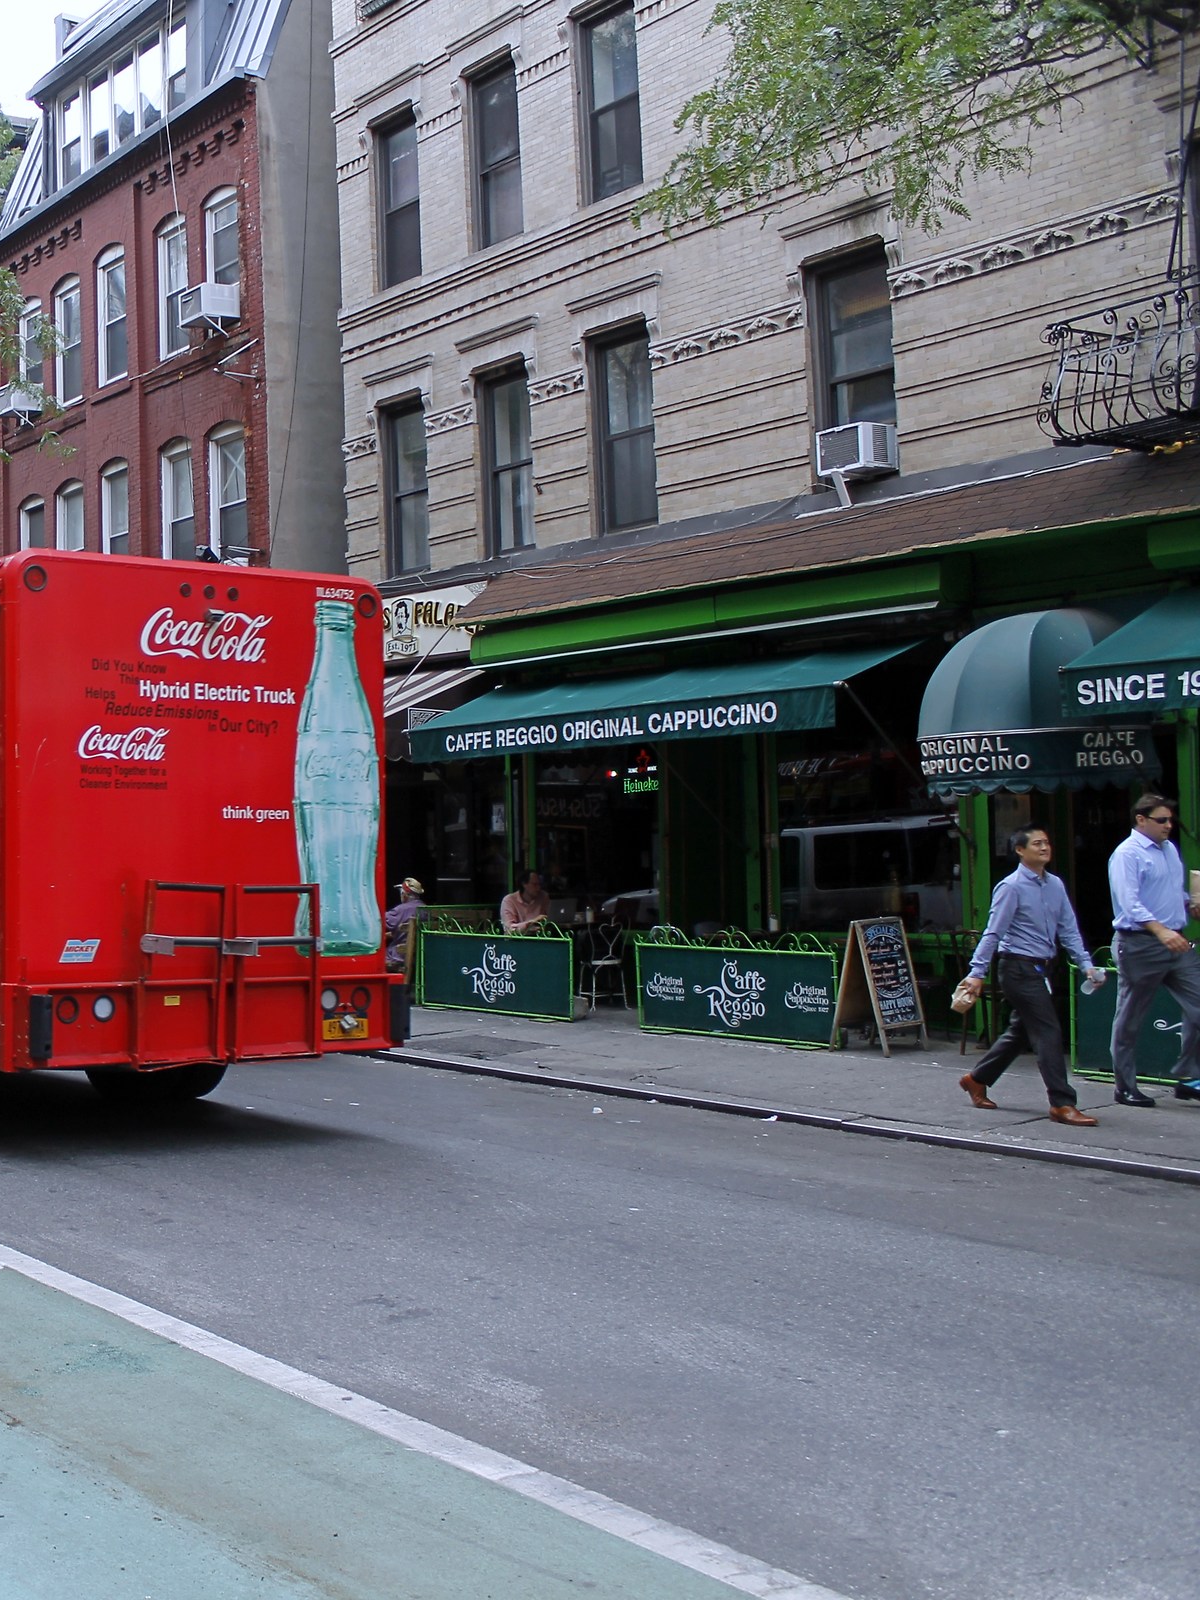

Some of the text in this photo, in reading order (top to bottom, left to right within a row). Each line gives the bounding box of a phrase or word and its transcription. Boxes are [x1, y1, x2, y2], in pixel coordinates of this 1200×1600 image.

[414, 602, 478, 635] FALA
[140, 607, 273, 662] Coca-Cola
[388, 641, 417, 653] Est. 1971
[92, 658, 167, 674] Did You Know
[85, 687, 116, 701] Helps
[119, 673, 296, 705] This Hybrid Electric Truck
[1077, 673, 1166, 705] SINCE
[104, 701, 220, 720] Reduce Emissions
[208, 718, 279, 736] in Our City?
[445, 701, 777, 753] CAFFE REGGIO ORIGINAL CAPPUCCINO
[78, 724, 171, 761] Coca-Cola
[920, 736, 1009, 757] ORIGINAL
[80, 764, 167, 778] Working Together for a
[920, 754, 1031, 776] CAPPUCCINO
[79, 779, 168, 791] Cleaner Environment
[222, 805, 290, 823] think green
[65, 945, 96, 953] MICKEY
[482, 943, 517, 979] Caffe
[461, 966, 516, 1004] Reggio
[653, 972, 683, 986] Original
[721, 958, 766, 1000] Caffe
[646, 981, 685, 997] Cappuccino
[793, 982, 827, 996] Original
[693, 984, 766, 1028] Reggio
[784, 991, 829, 1009] Cappuccino
